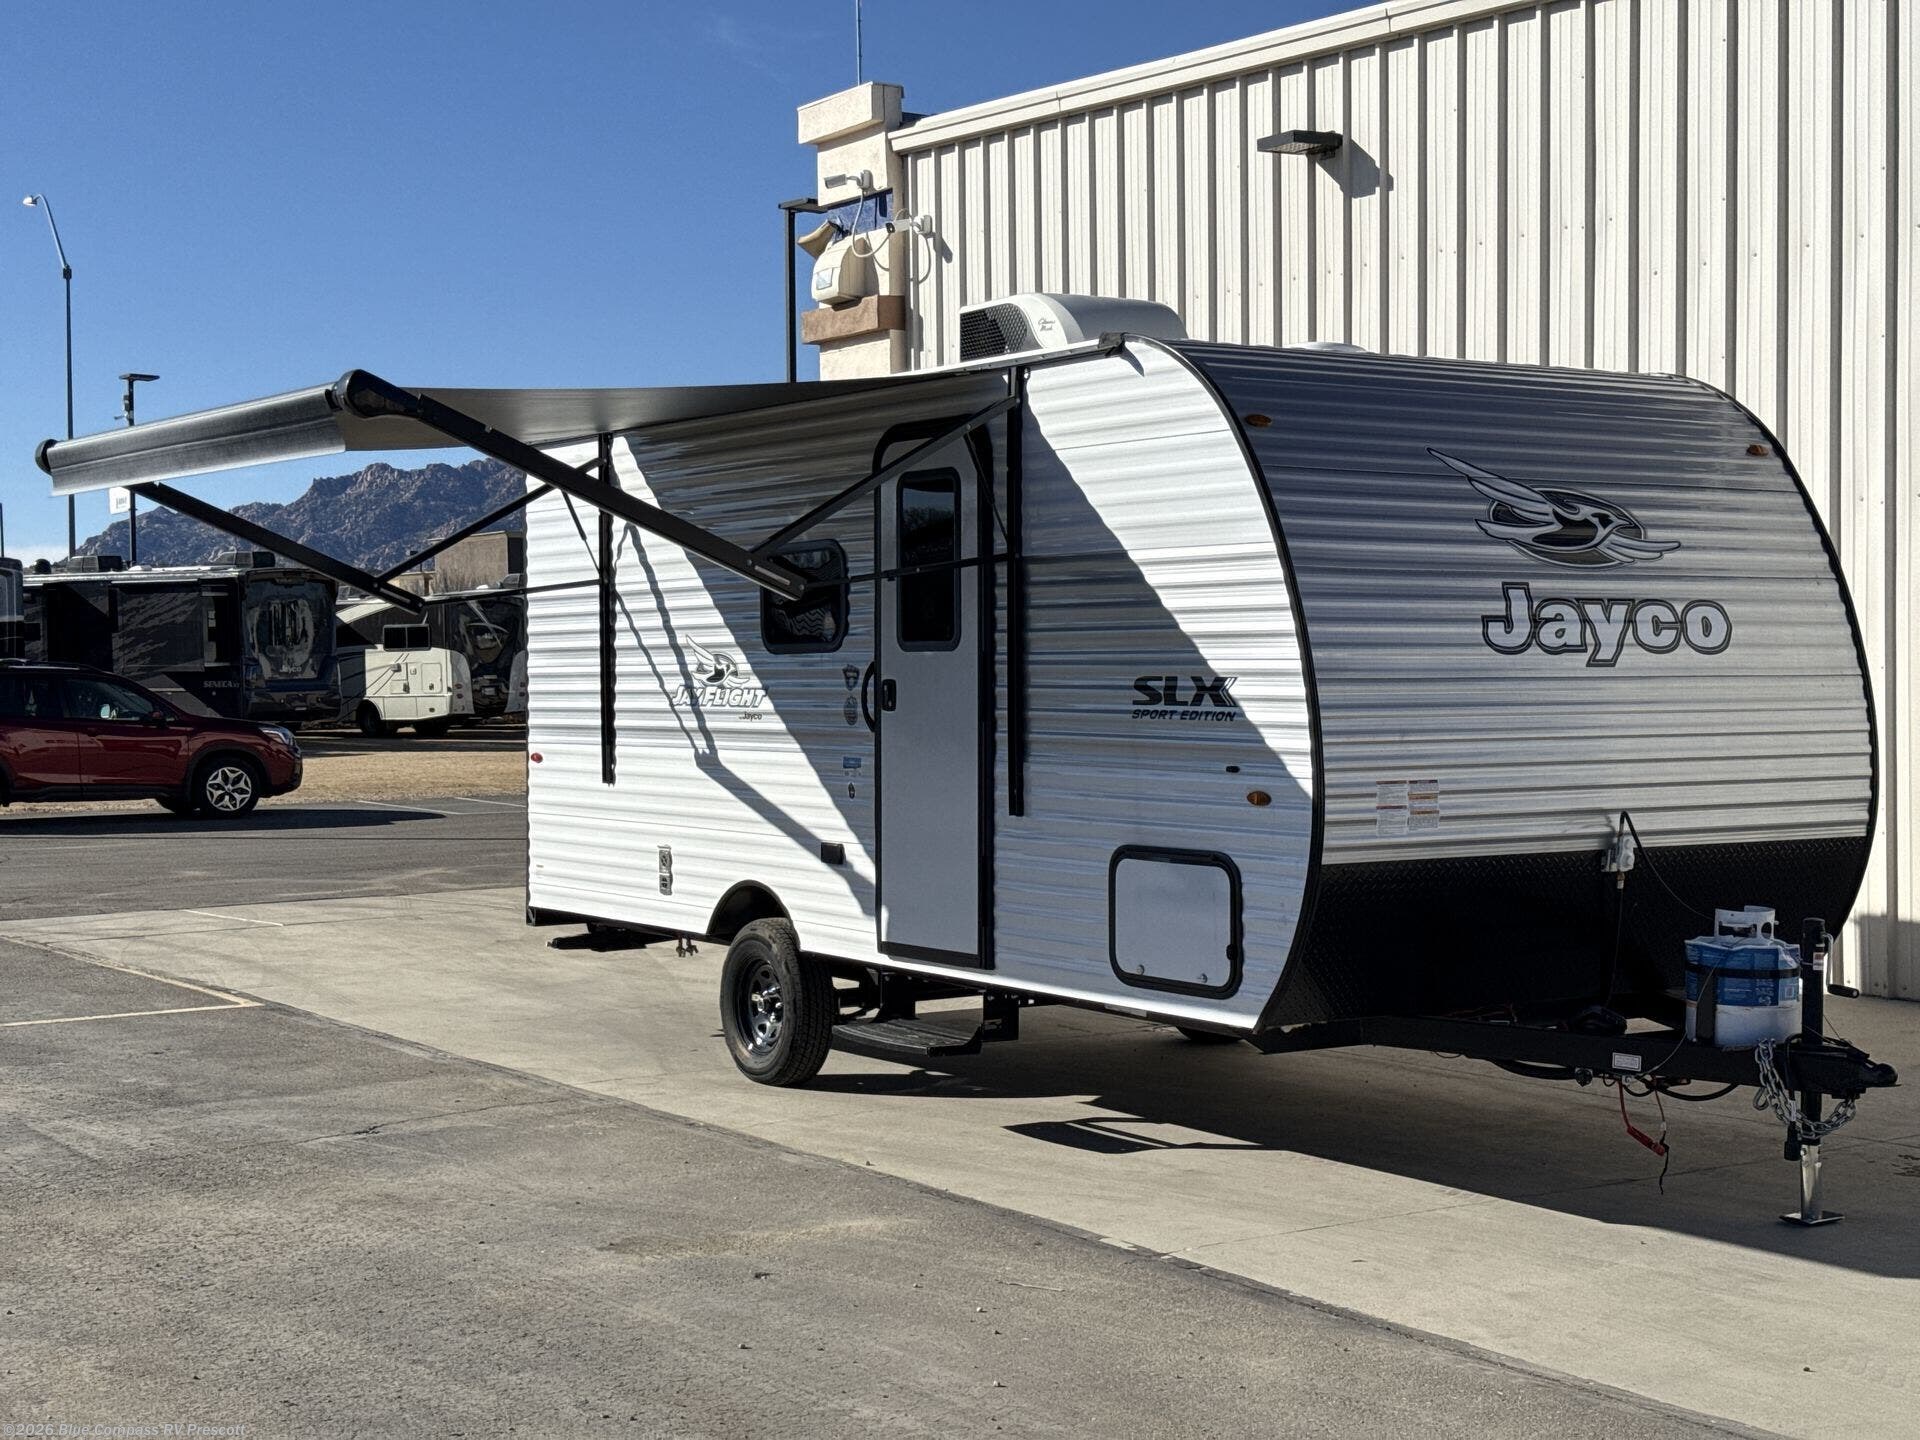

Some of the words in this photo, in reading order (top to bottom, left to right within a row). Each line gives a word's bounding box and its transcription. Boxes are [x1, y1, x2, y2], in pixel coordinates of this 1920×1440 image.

[1481, 581, 1733, 668] Jayco
[672, 685, 704, 707] JAY
[700, 686, 768, 708] FLIGHT
[1132, 675, 1239, 707] SLX
[742, 711, 763, 722] Jayco
[1131, 708, 1178, 720] SPORT
[1179, 709, 1236, 722] EDITION
